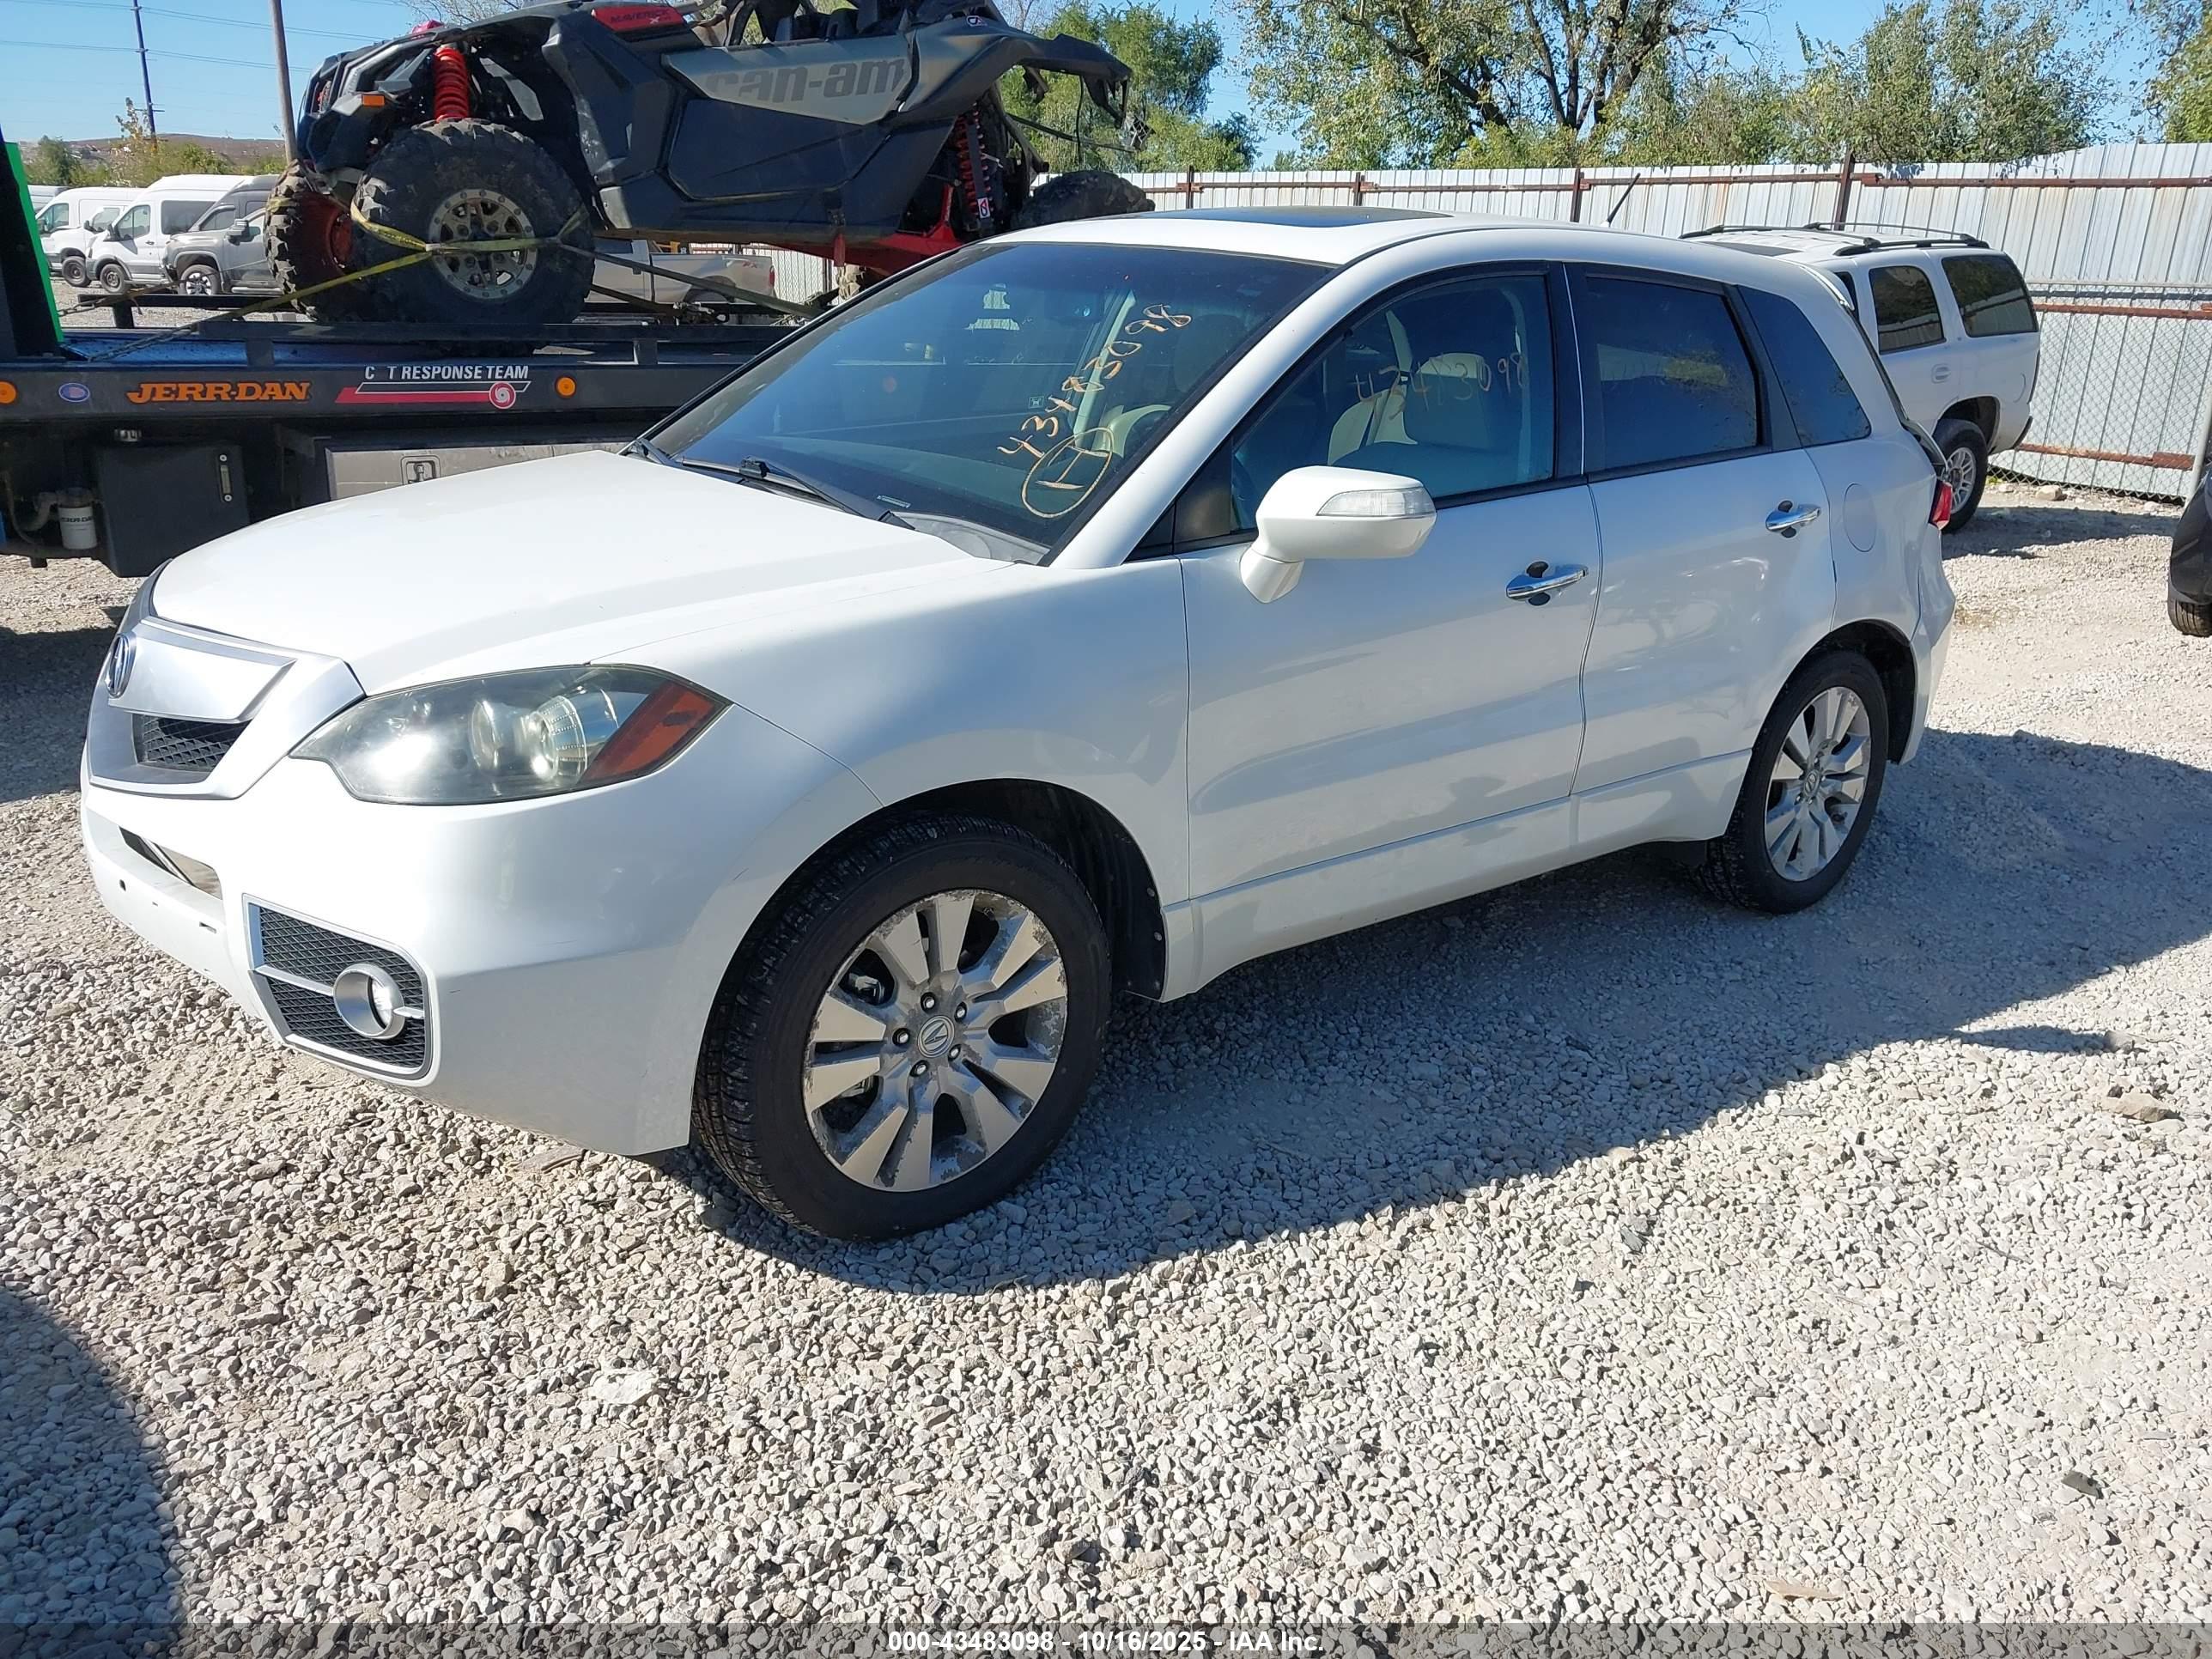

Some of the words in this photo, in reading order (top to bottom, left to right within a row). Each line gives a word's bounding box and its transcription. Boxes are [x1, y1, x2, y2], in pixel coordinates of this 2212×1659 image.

[704, 58, 906, 104] can-am
[401, 365, 483, 380] RESPONSE
[486, 365, 530, 380] TEAM
[997, 303, 1192, 459] 43483098
[126, 381, 313, 404] JERR-DAN
